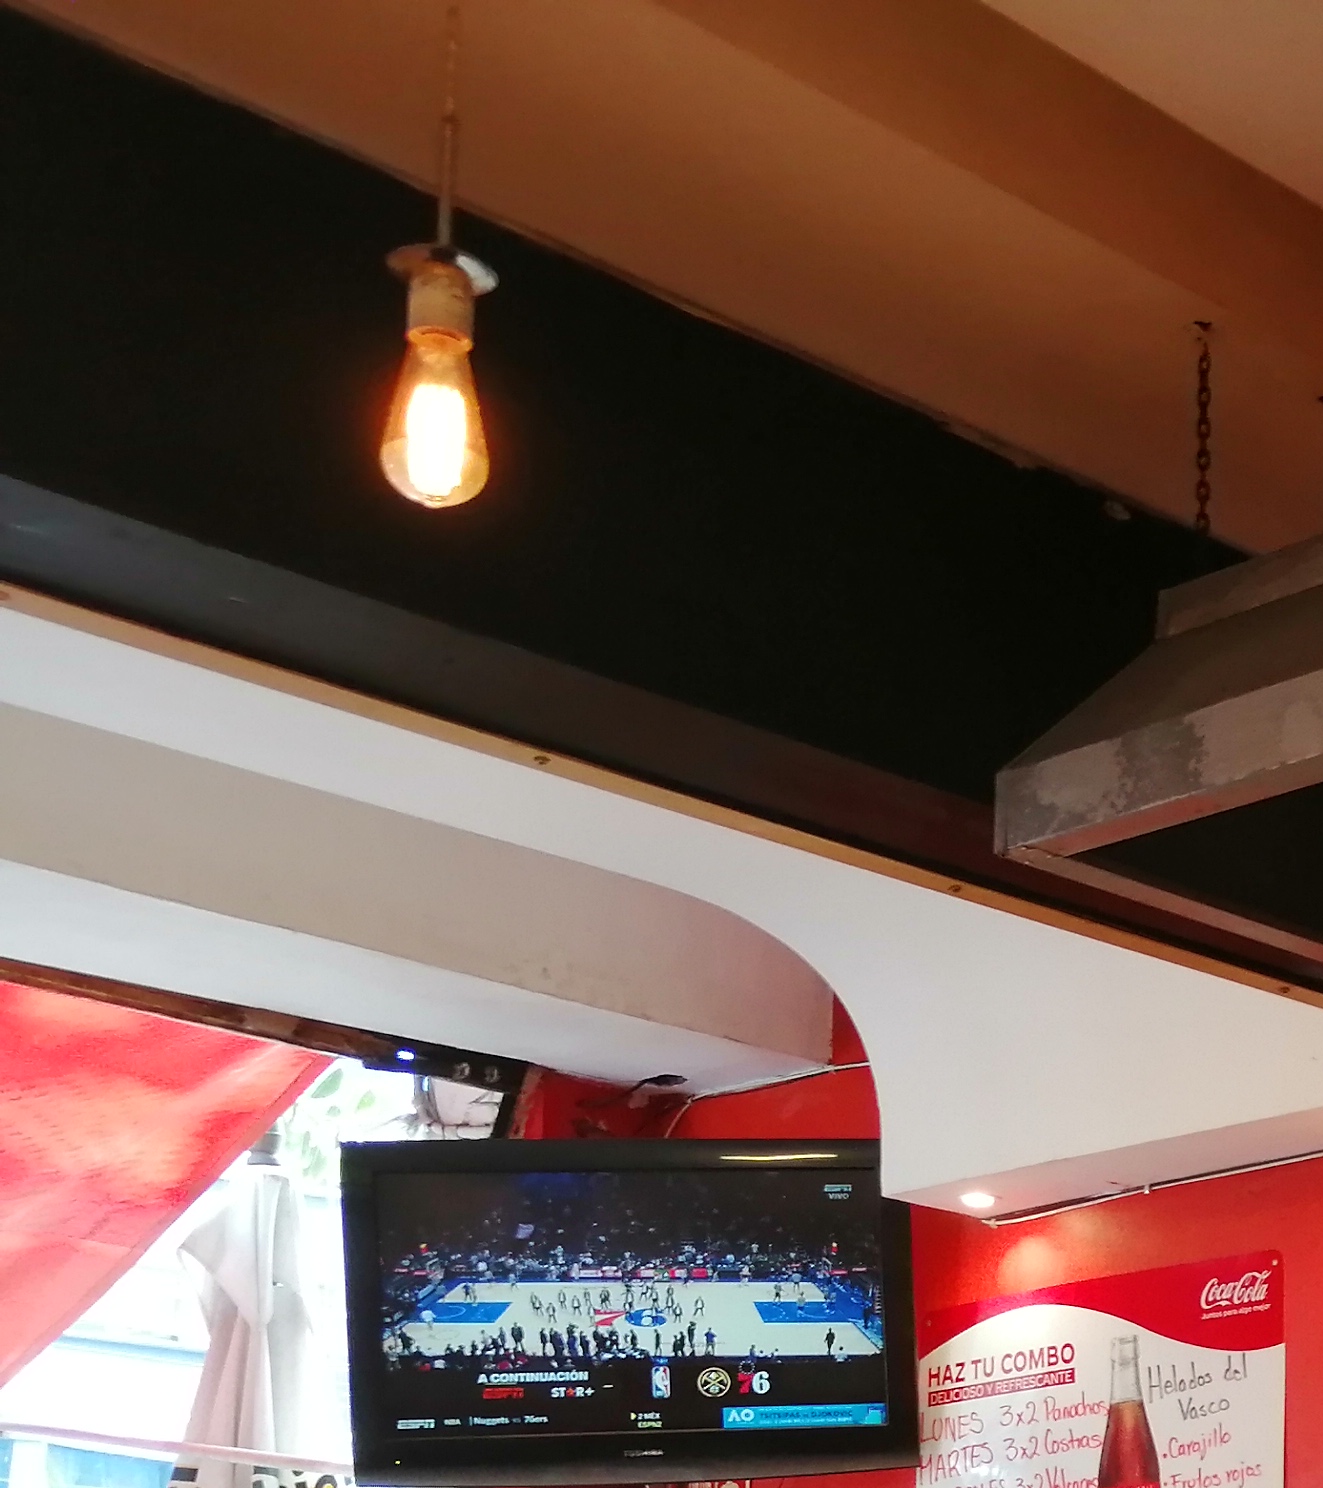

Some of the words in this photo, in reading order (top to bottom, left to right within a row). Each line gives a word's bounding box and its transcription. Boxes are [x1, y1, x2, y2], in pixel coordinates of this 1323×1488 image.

[1200, 1270, 1272, 1310] Coca-Cola
[477, 1373, 487, 1385] A
[489, 1370, 589, 1384] CONTINUACIÓN
[928, 1363, 966, 1388] HAZ
[971, 1356, 995, 1380] TU
[1001, 1343, 1075, 1374] COMBO
[1148, 1361, 1212, 1403] Helados
[929, 1384, 984, 1405] DELICIOSO
[986, 1383, 996, 1395] Y
[996, 1369, 1073, 1394] REFRESCANTE
[919, 1411, 984, 1443] LUNES
[1178, 1397, 1230, 1421] Vasco
[918, 1442, 994, 1486] MARTES
